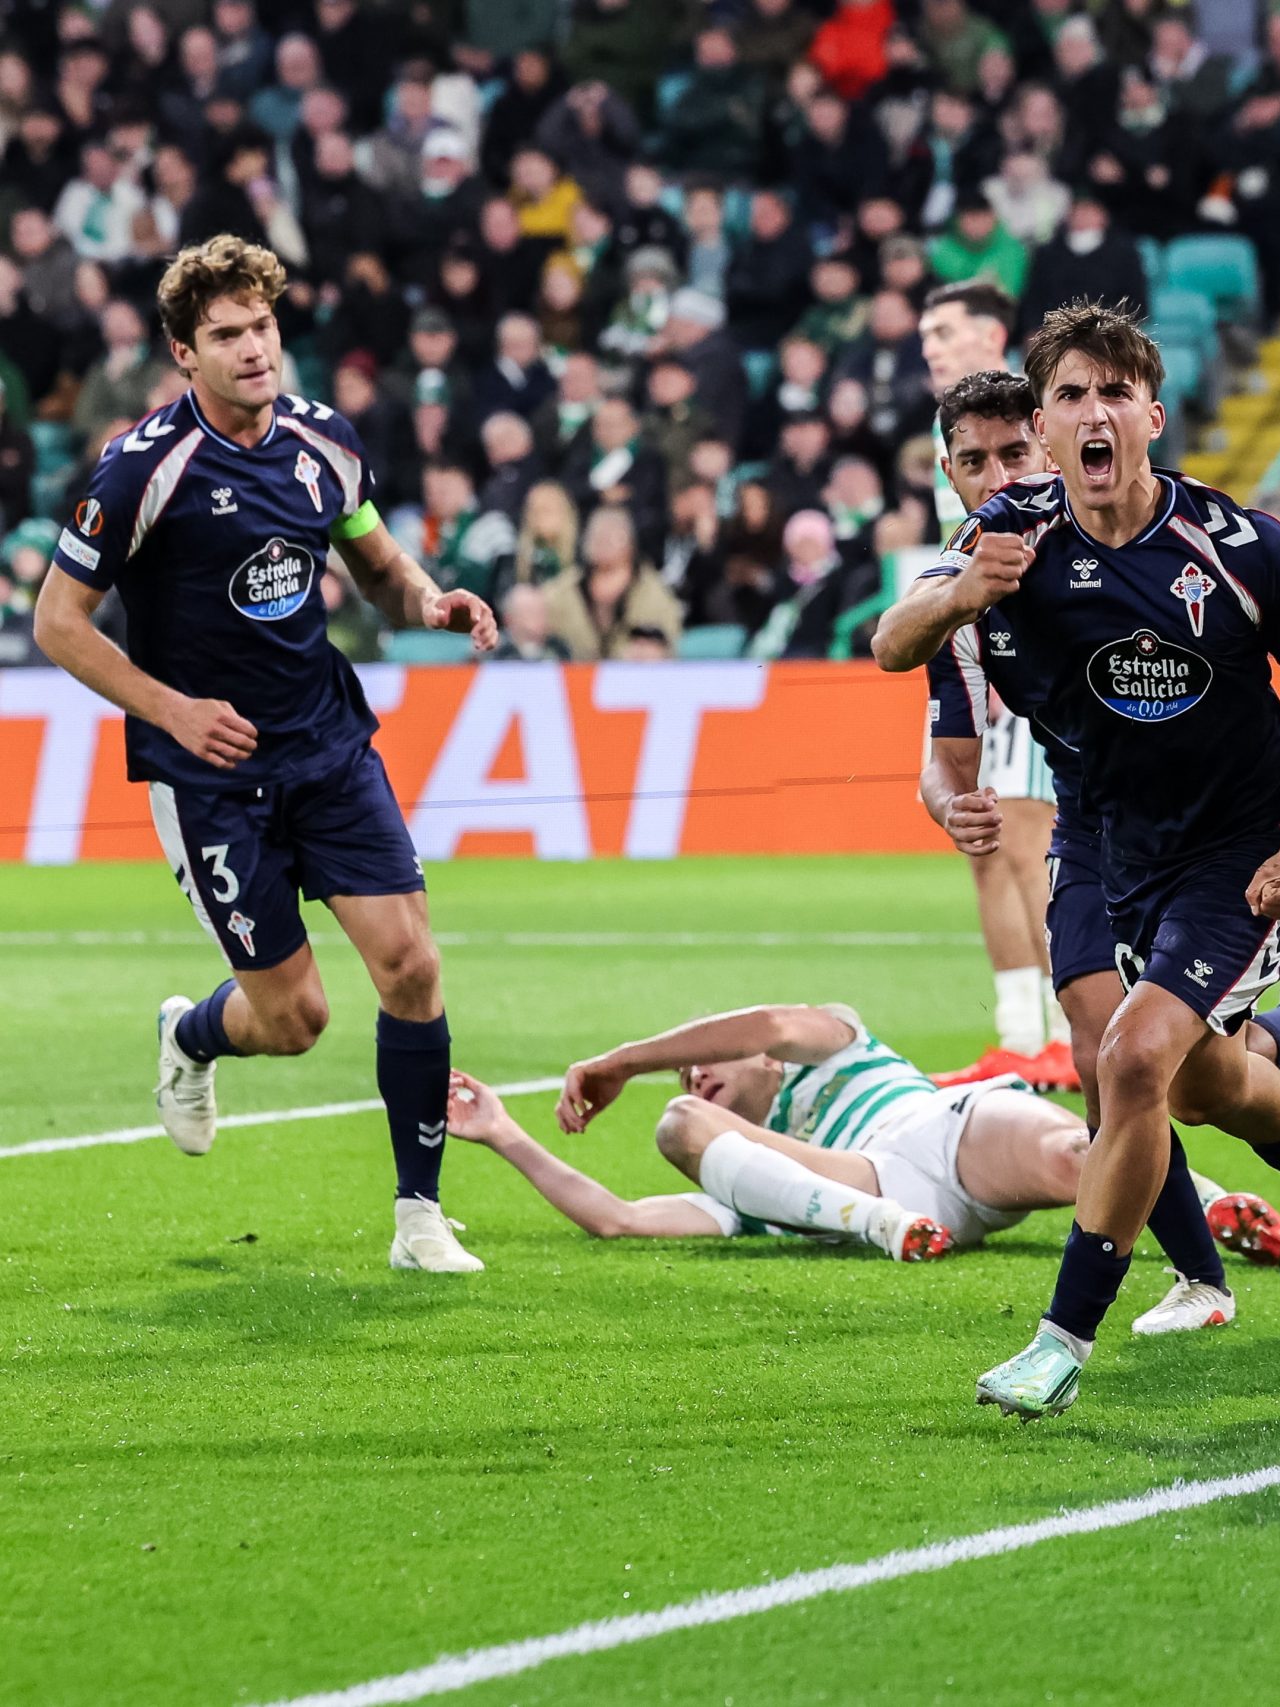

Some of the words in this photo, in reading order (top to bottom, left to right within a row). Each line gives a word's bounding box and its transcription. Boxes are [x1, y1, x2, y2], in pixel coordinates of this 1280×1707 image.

[246, 557, 302, 585] Estrella
[1070, 578, 1102, 589] hummel
[248, 576, 299, 603] Galicia
[1108, 653, 1191, 678] Estrella
[1112, 675, 1188, 698] Galicia
[1138, 699, 1164, 717] 0,0
[353, 662, 768, 862] AT
[201, 844, 240, 904] 3
[1183, 967, 1209, 989] hummel
